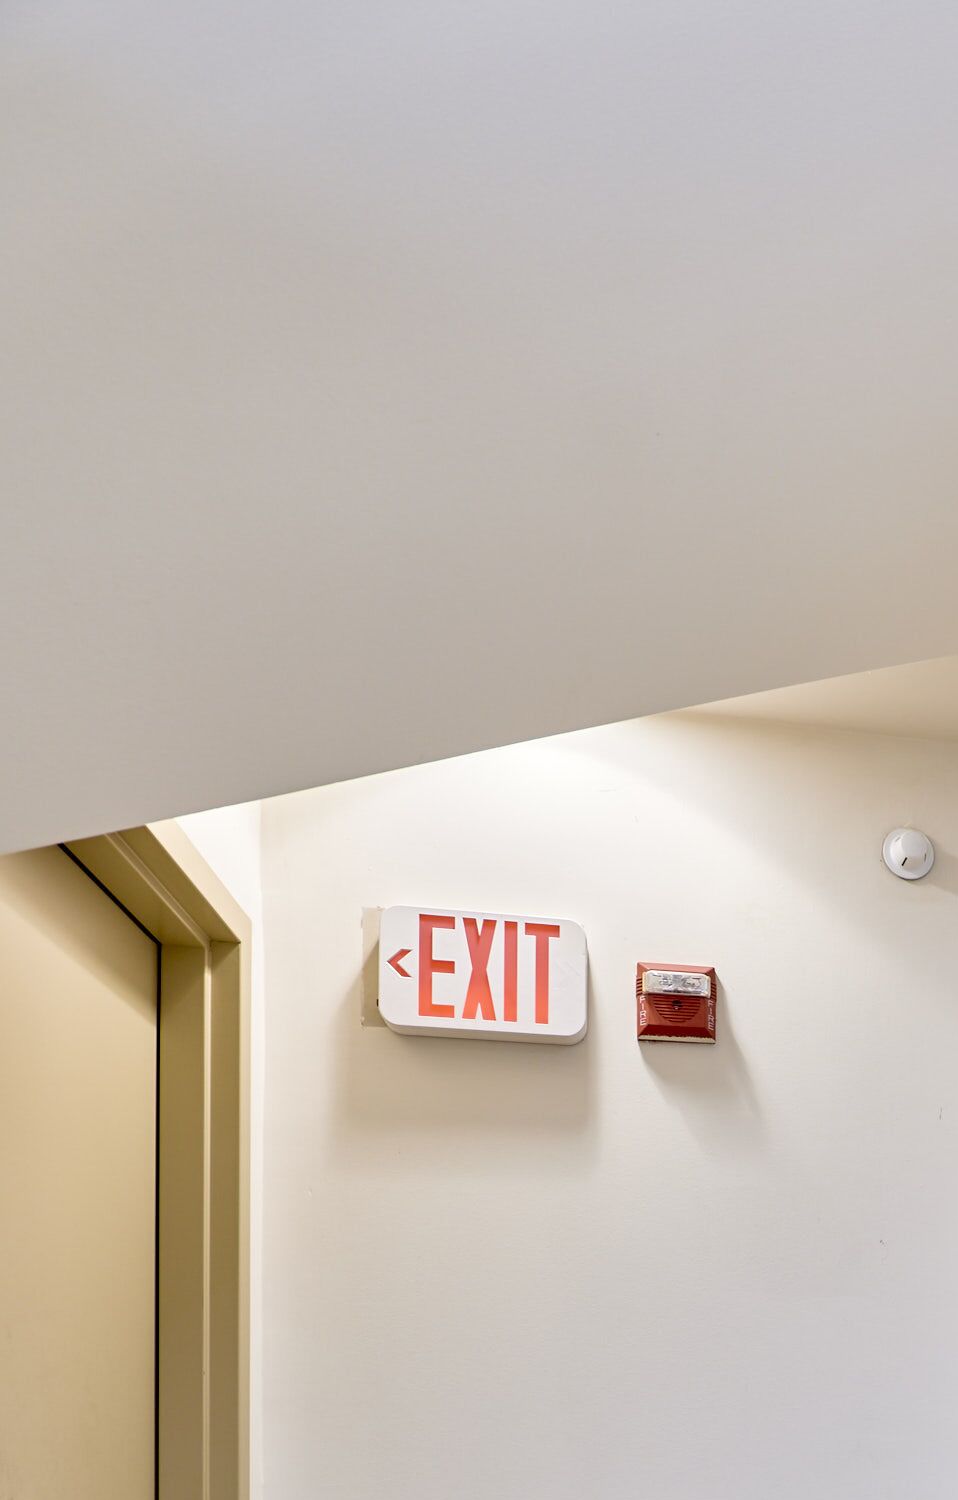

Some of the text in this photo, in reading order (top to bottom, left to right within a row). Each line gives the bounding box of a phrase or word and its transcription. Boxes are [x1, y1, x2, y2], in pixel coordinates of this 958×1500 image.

[418, 913, 561, 1025] EXIT
[639, 995, 647, 1026] FIRE
[707, 1000, 715, 1031] FIRE
